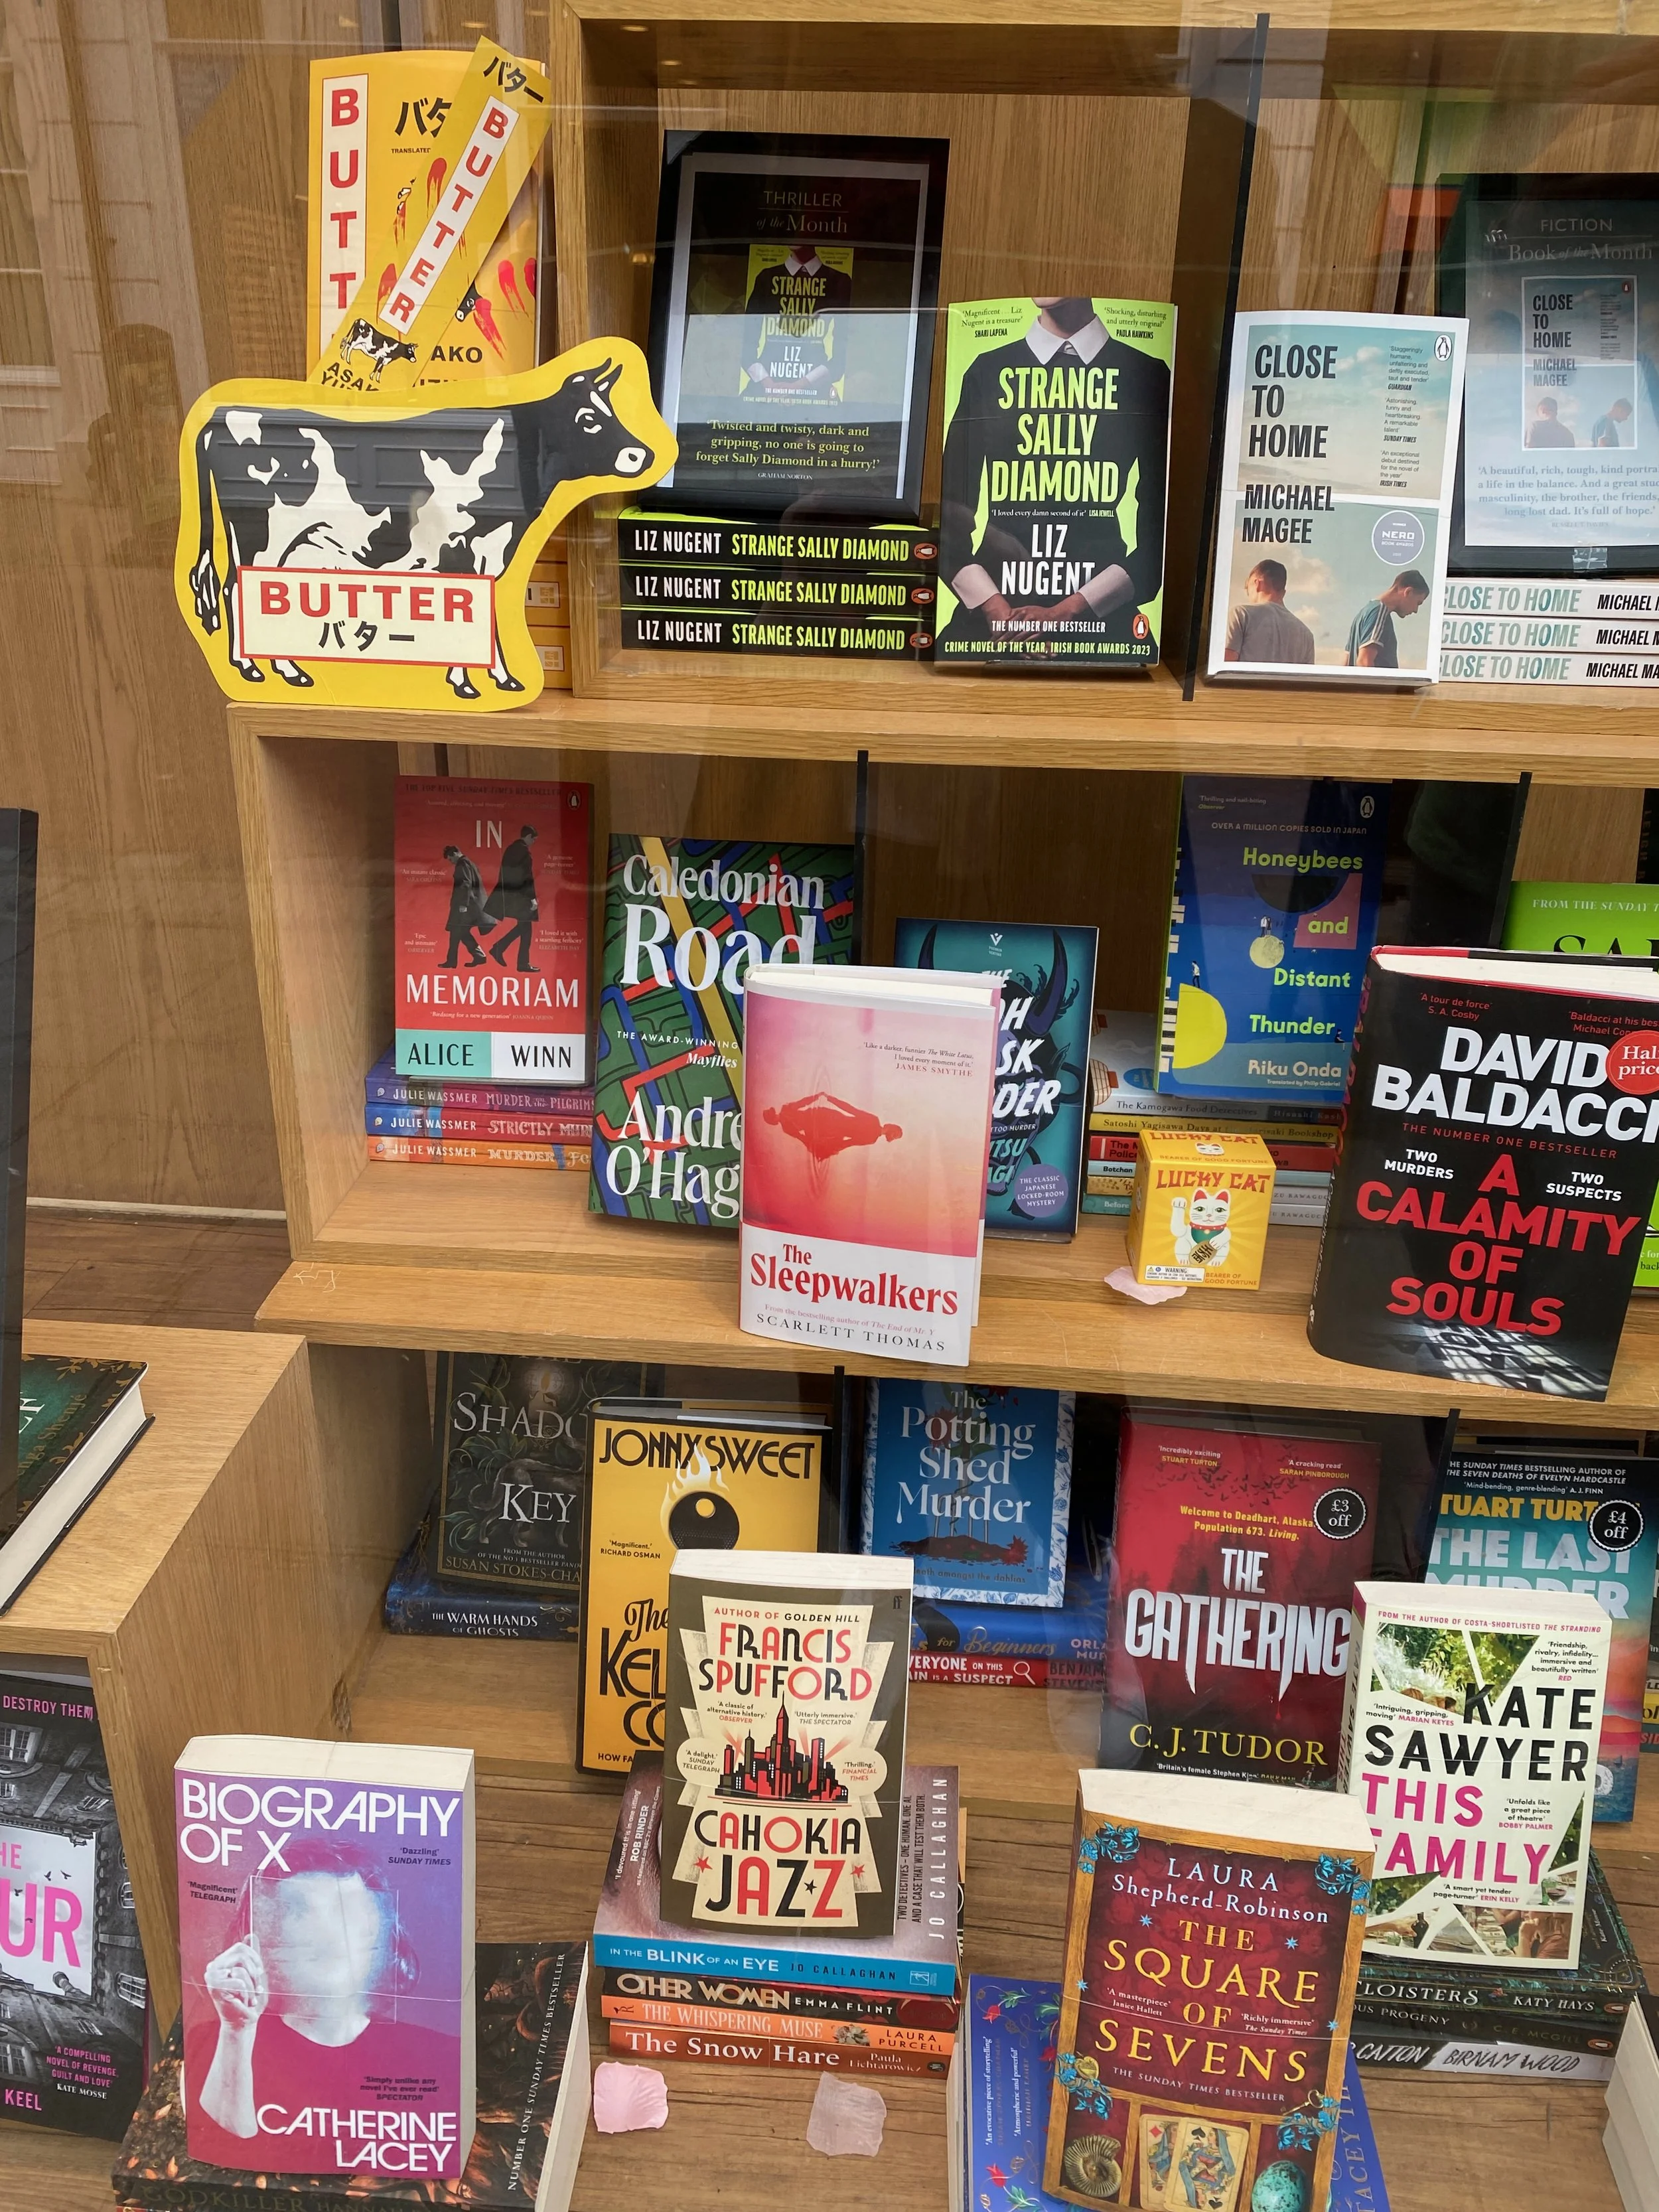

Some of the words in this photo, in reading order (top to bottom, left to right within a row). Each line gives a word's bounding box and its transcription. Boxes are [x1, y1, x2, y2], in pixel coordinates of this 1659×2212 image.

[483, 56, 543, 103] バター
[389, 107, 508, 323] BUTTER
[764, 190, 841, 208] THRILLER
[757, 218, 766, 230] of
[770, 216, 784, 228] the
[786, 214, 847, 233] Month
[1541, 219, 1613, 232] FICTION
[1119, 319, 1138, 327] utterly
[1137, 309, 1167, 320] disturbing
[1132, 331, 1153, 339] HAWKINS
[1254, 344, 1338, 379] CLOSE
[999, 367, 1119, 410] STRANGE
[1252, 385, 1284, 418] TO
[757, 422, 777, 432] and
[780, 423, 816, 435] twisty,
[819, 424, 845, 435] dark
[848, 425, 869, 437] and
[1017, 413, 1097, 455] SALLY
[1249, 425, 1329, 458] HOME
[992, 461, 1118, 503] DIAMOND
[1244, 484, 1335, 512] MICHAEL
[1032, 524, 1066, 559] LIZ
[1242, 517, 1313, 544] MAGEE
[1382, 530, 1415, 540] NERO
[1001, 561, 1095, 596] NUGENT
[260, 581, 473, 623] BUTTER
[319, 621, 415, 650] バター
[638, 621, 659, 640] LIZ
[665, 621, 721, 643] NUGENT
[732, 624, 792, 646] STRANGE
[796, 626, 836, 647] SALLY
[840, 628, 904, 650] DIAMOND
[992, 621, 1005, 631] THE
[1008, 621, 1040, 632] NUMBER
[1043, 621, 1057, 632] ONE
[1060, 621, 1106, 633] BESTSELLER
[476, 820, 503, 848] IN
[1244, 848, 1363, 873] Honeybees
[623, 853, 824, 910] Caledonian
[1308, 917, 1348, 934] and
[407, 974, 579, 1007] MEMORIAM
[1274, 968, 1351, 988] Distant
[1250, 1015, 1335, 1034] Thunder
[1428, 1006, 1438, 1015] S.
[1439, 1007, 1451, 1016] A.
[1452, 1009, 1480, 1023] Cosby
[407, 1042, 474, 1066] ALICE
[511, 1044, 571, 1069] WINN
[686, 1052, 738, 1069] Mayflies
[896, 1063, 928, 1073] JAMES
[931, 1067, 973, 1077] SMYTHE
[1248, 1060, 1287, 1076] Riku
[1293, 1061, 1341, 1078] Onda
[1441, 1027, 1609, 1088] DAVID
[1117, 1100, 1133, 1109] The
[1137, 1102, 1183, 1113] Kamogawa
[1185, 1104, 1207, 1113] Food
[1210, 1106, 1257, 1116] Detectives
[391, 1117, 423, 1129] JULIE
[426, 1118, 476, 1132] WASSMER
[488, 1120, 553, 1136] STRICTLY
[1384, 1160, 1454, 1180] MURDERS
[1406, 1148, 1438, 1163] TWO
[1156, 1170, 1224, 1189] LUCKY
[1230, 1174, 1270, 1193] CAT
[1479, 1154, 1521, 1196] A
[1017, 1191, 1064, 1199] LOCKED-ROOM
[1356, 1181, 1640, 1256] CALAMITY
[783, 1244, 812, 1266] The
[1449, 1241, 1524, 1284] OF
[751, 1253, 958, 1315] Sleepwalkers
[1386, 1278, 1565, 1337] SOULS
[757, 1313, 855, 1339] SCARLETT
[863, 1331, 945, 1351] THOMAS
[951, 1390, 986, 1410] The
[901, 1406, 1036, 1460] Potting
[599, 1428, 701, 1469] JONNY
[705, 1436, 815, 1479] SWEET
[920, 1445, 1011, 1485] Shed
[498, 1483, 575, 1524] KEY
[896, 1482, 1031, 1524] Murder
[1331, 1499, 1349, 1512] £3
[1609, 1511, 1626, 1524] £4
[1328, 1514, 1352, 1528] off
[1604, 1526, 1628, 1540] off
[601, 1548, 632, 1557] RICHARD
[634, 1551, 660, 1560] OSMAN
[1221, 1548, 1269, 1593] THE
[447, 1612, 489, 1625] WARM
[494, 1615, 538, 1627] HANDS
[720, 1623, 851, 1663] FRANCIS
[1125, 1589, 1352, 1703] GATHERING
[699, 1659, 872, 1700] SPUFFORD
[3, 1694, 57, 1715] DESTROY
[61, 1703, 94, 1722] THEM
[719, 1716, 753, 1724] OBSERVER
[1463, 1683, 1596, 1730] KATE
[1129, 1724, 1159, 1749] C.
[1163, 1727, 1186, 1757] J.
[1194, 1730, 1328, 1765] TUDOR
[1364, 1725, 1588, 1781] SAWYER
[183, 1779, 461, 1837] BIOGRAPHY
[1362, 1773, 1483, 1827] THIS
[180, 1824, 243, 1865] OF
[257, 1831, 291, 1872] X
[694, 1810, 860, 1854] CAHOKIA
[705, 1854, 845, 1918] JAZZ
[1168, 1858, 1279, 1893] LAURA
[1112, 1874, 1328, 1924] Shepherd-Robinson
[1179, 1920, 1254, 1951] THE
[647, 1949, 705, 1965] BLINK
[743, 1957, 779, 1972] EYE
[1104, 1940, 1319, 2008] SQUARE
[616, 1973, 692, 2000] OTHER
[698, 1981, 790, 2010] WOMEN
[1514, 1996, 1552, 2009] KATY
[1557, 2000, 1595, 2012] HAYS
[1183, 2002, 1232, 2028] OF
[625, 2031, 677, 2053] The
[687, 2037, 763, 2060] Snow
[773, 2045, 839, 2066] Hare
[1095, 2020, 1308, 2082] SEVENS
[1443, 2049, 1517, 2069] BIRNAM
[1521, 2055, 1580, 2073] WOOD
[5, 2091, 41, 2111] KEEL
[257, 2104, 457, 2142] CATHERINE
[336, 2140, 452, 2173] LACEY
